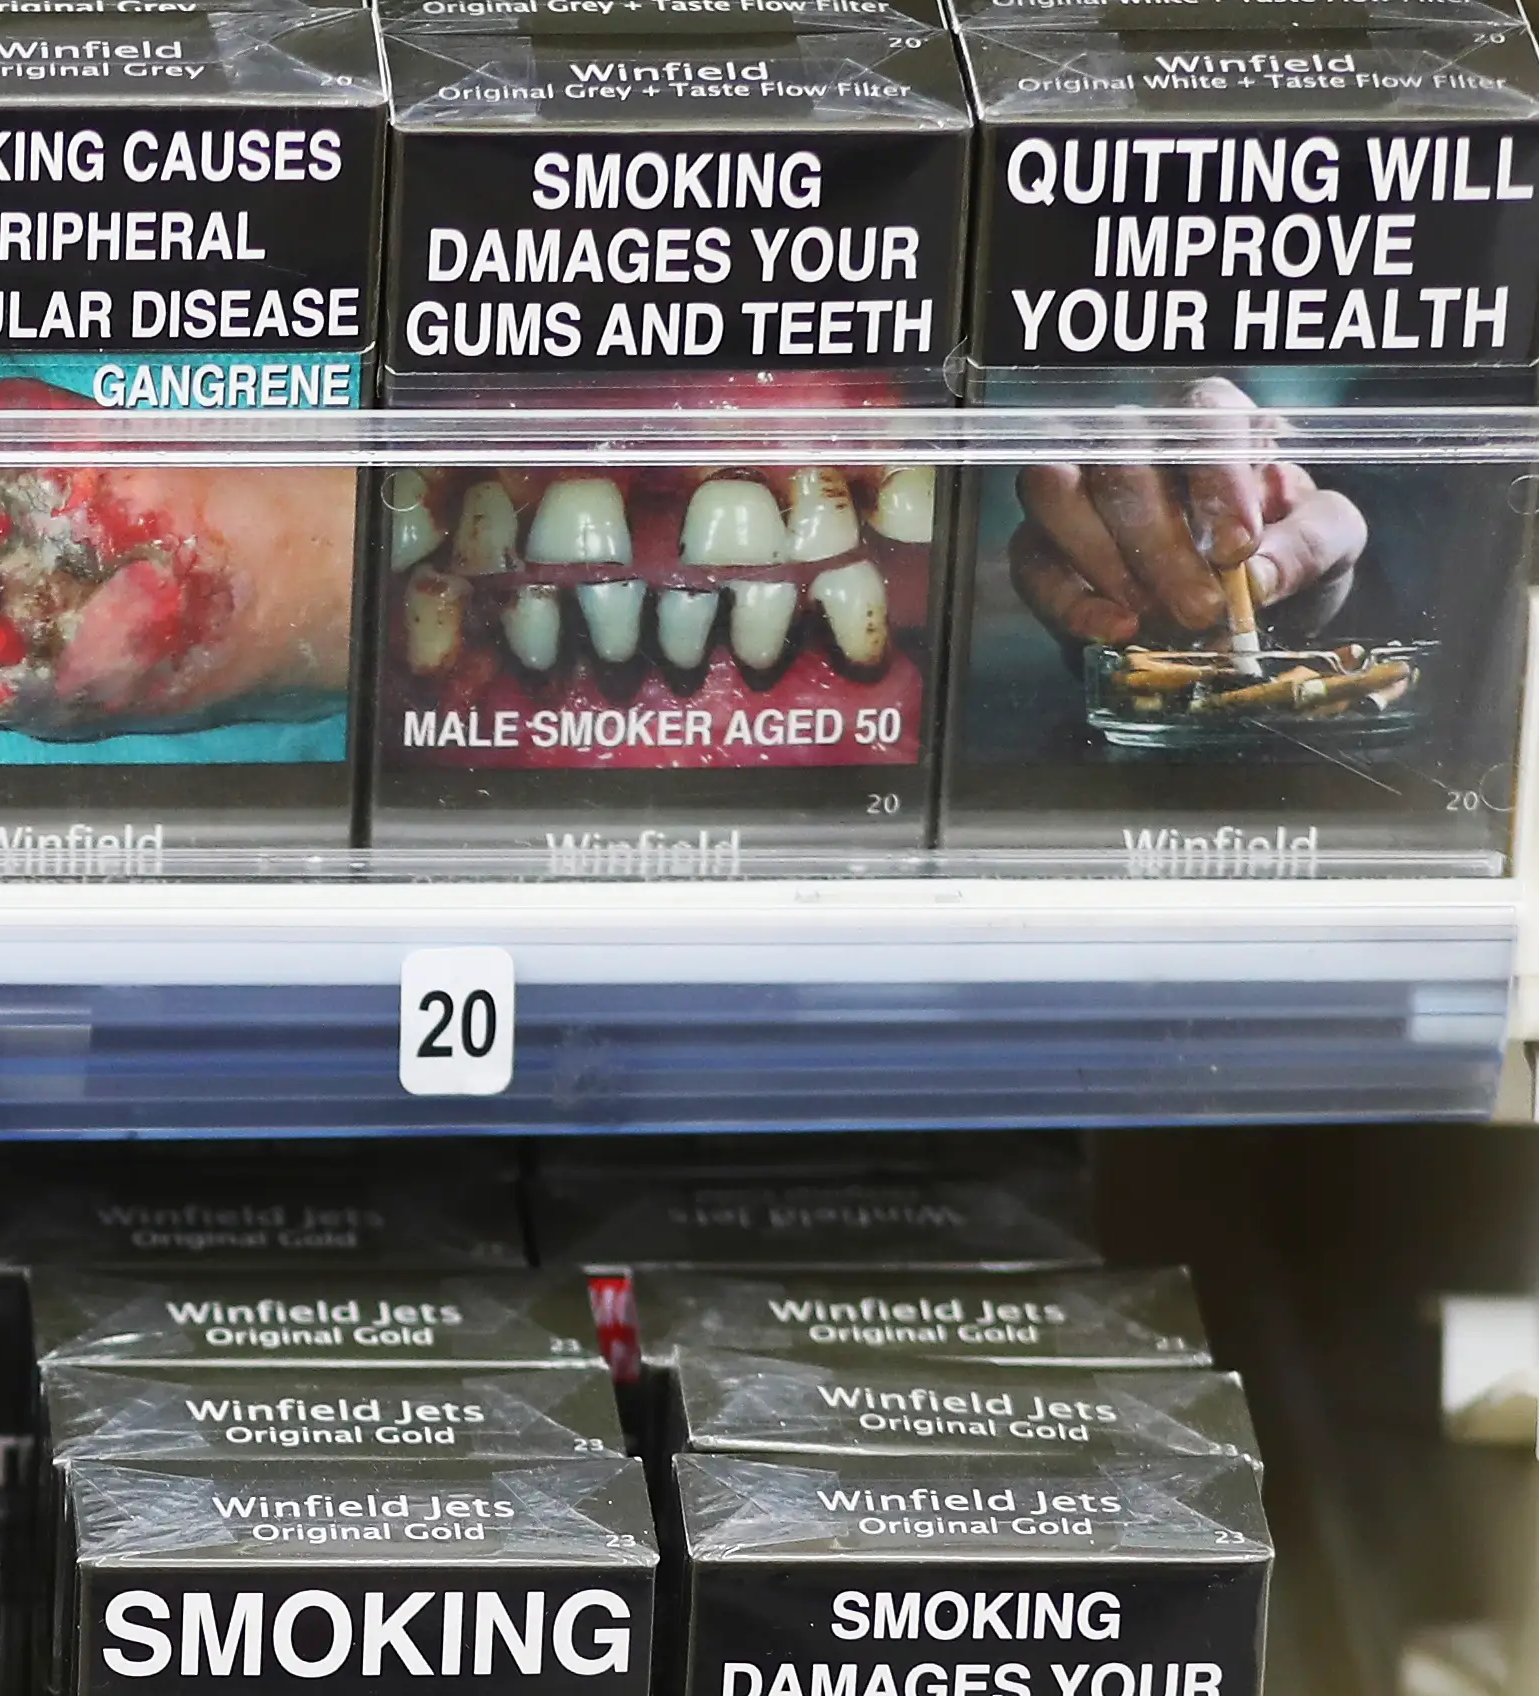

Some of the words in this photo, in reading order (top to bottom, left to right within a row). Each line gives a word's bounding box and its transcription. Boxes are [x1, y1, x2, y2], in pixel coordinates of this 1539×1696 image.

[124, 62, 204, 79] Grey
[124, 130, 341, 182] CAUSES
[1008, 137, 1338, 205] QUITTING
[1367, 137, 1533, 201] WILL
[1095, 214, 1415, 277] IMPROVE
[132, 288, 358, 338] DISEASE
[1012, 289, 1207, 351] YOUR
[1234, 286, 1508, 349] HEALTH
[93, 364, 349, 408] GANGRENE
[417, 990, 496, 1057] 20
[817, 1489, 1015, 1511] Winfield
[1031, 1491, 1121, 1515] Jets
[859, 1517, 1000, 1537] Original
[1012, 1518, 1092, 1534] Gold
[103, 1590, 630, 1677] SMOKING
